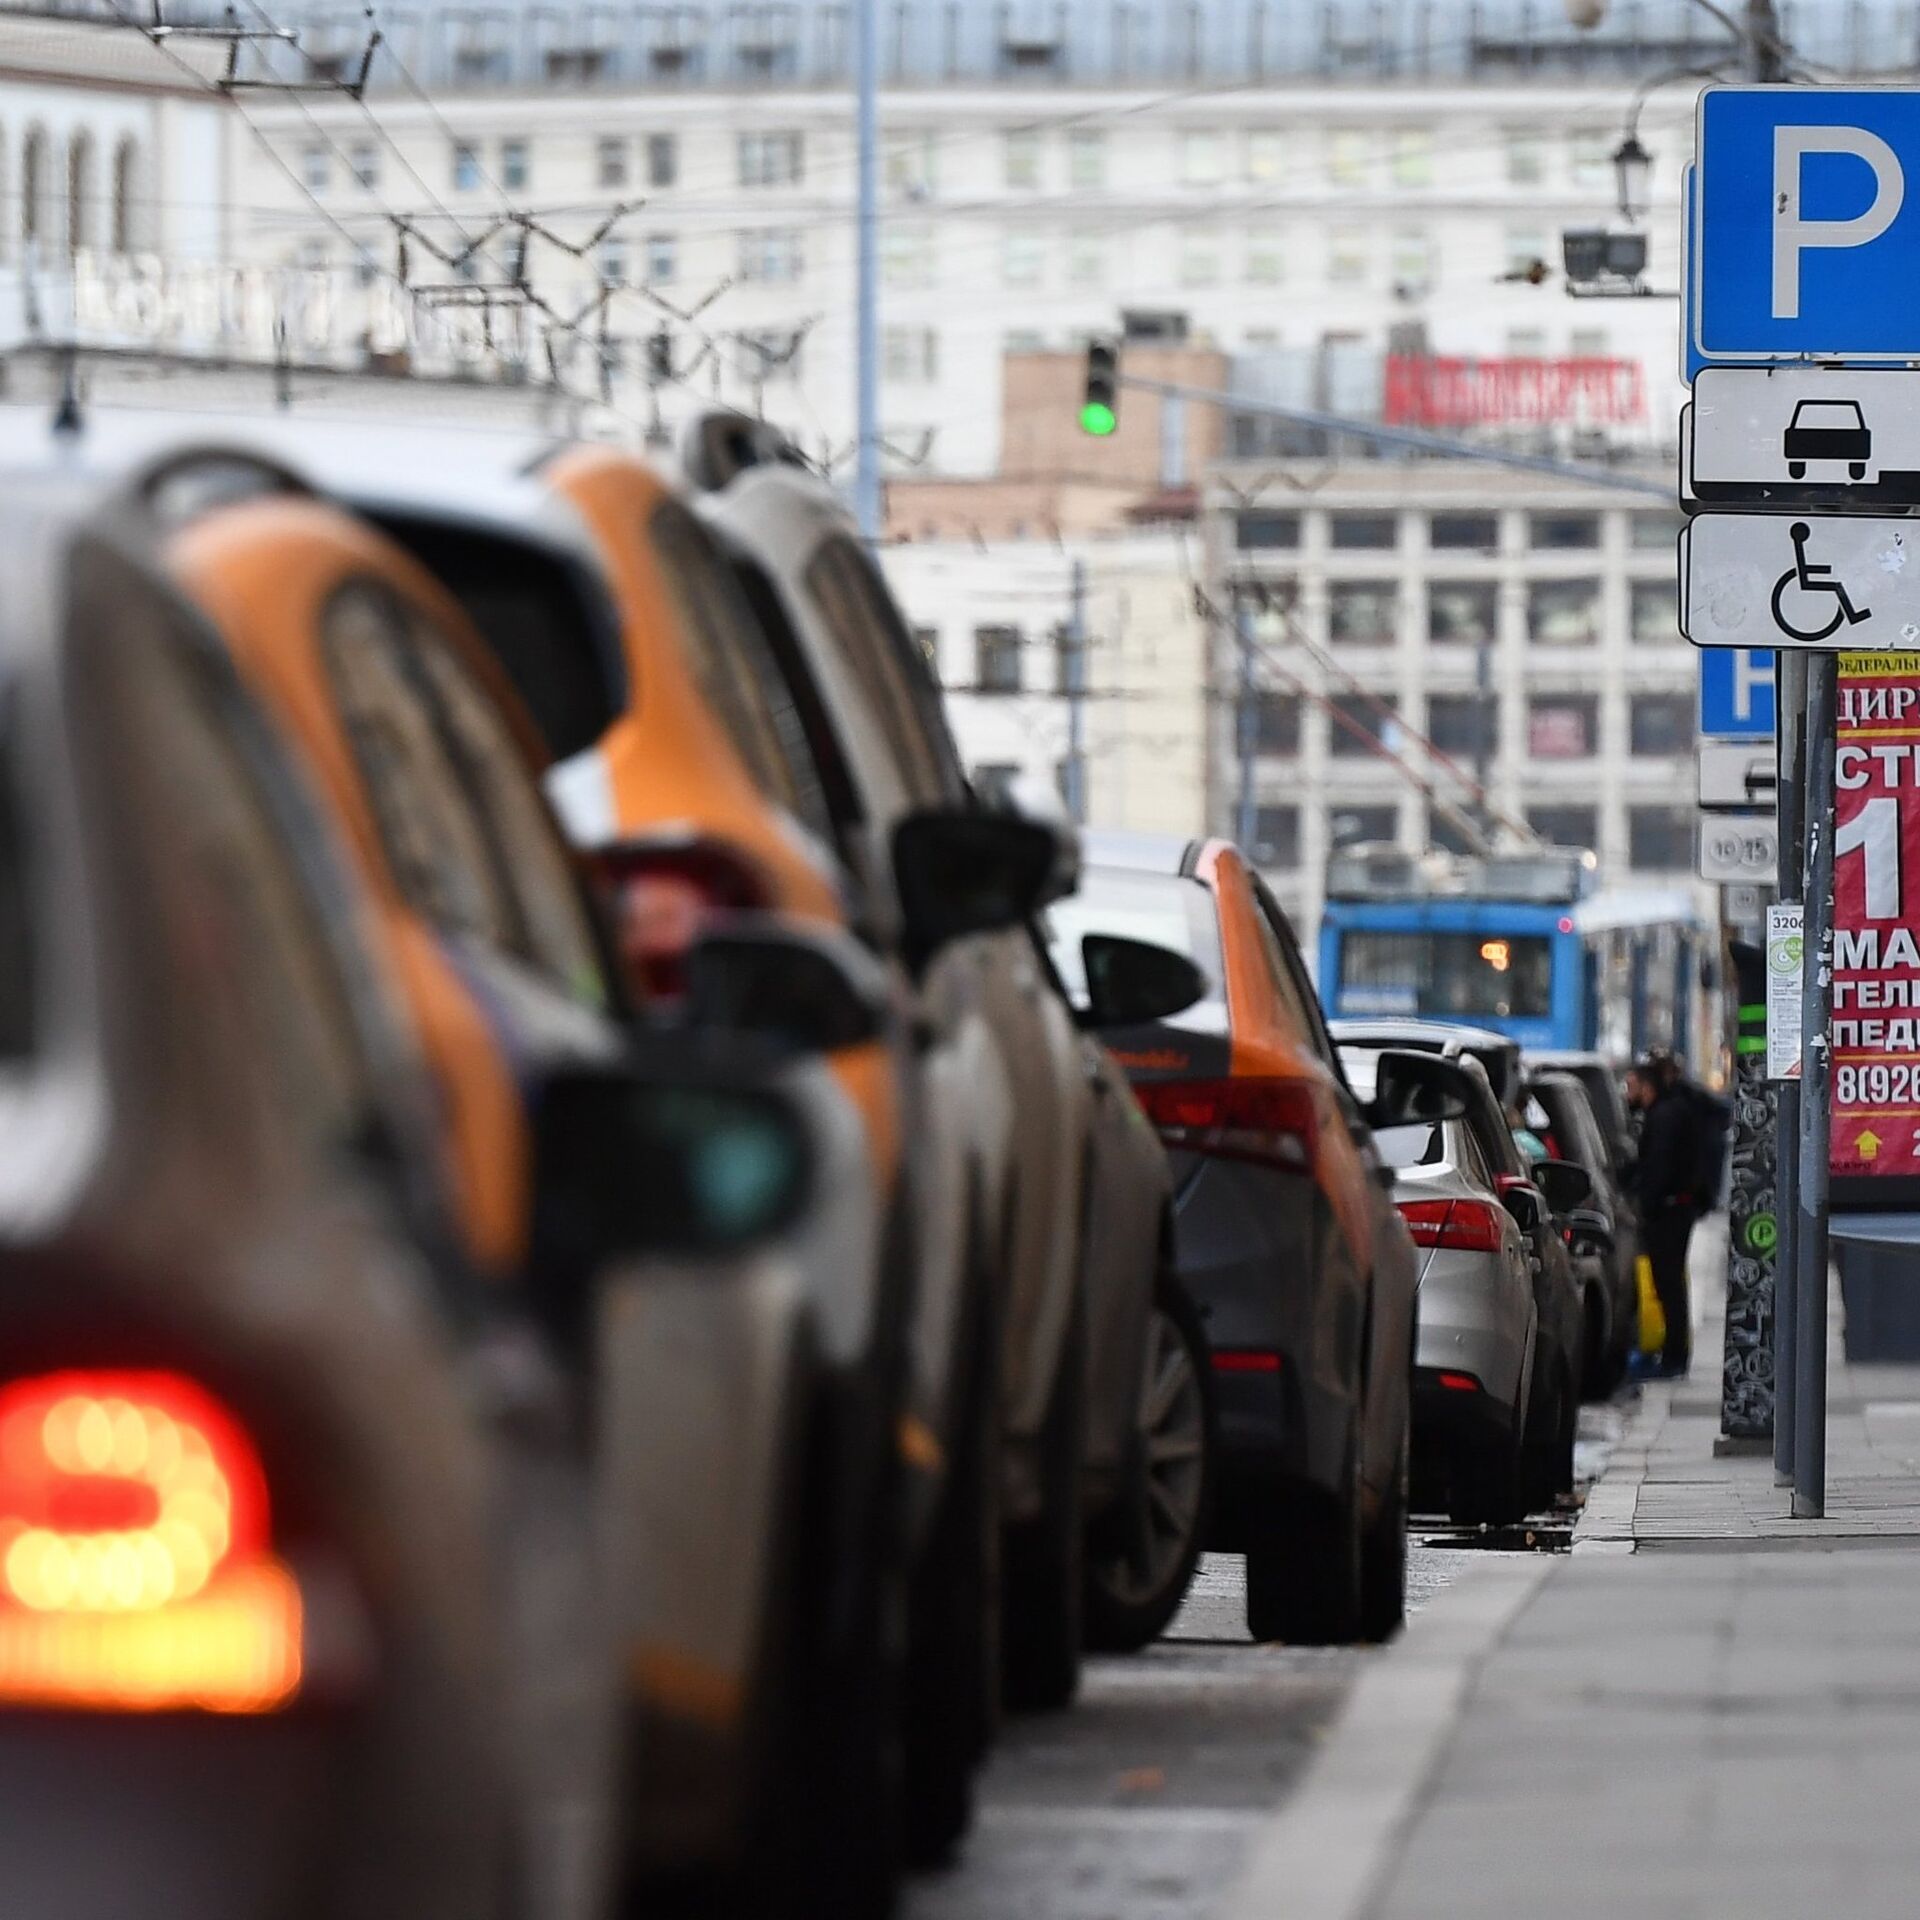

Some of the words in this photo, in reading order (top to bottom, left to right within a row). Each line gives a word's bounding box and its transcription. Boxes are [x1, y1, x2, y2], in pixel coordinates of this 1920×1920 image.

[1772, 125, 1904, 319] P
[1836, 745, 1920, 788] СТ
[1833, 1019, 1920, 1051] ПЕД
